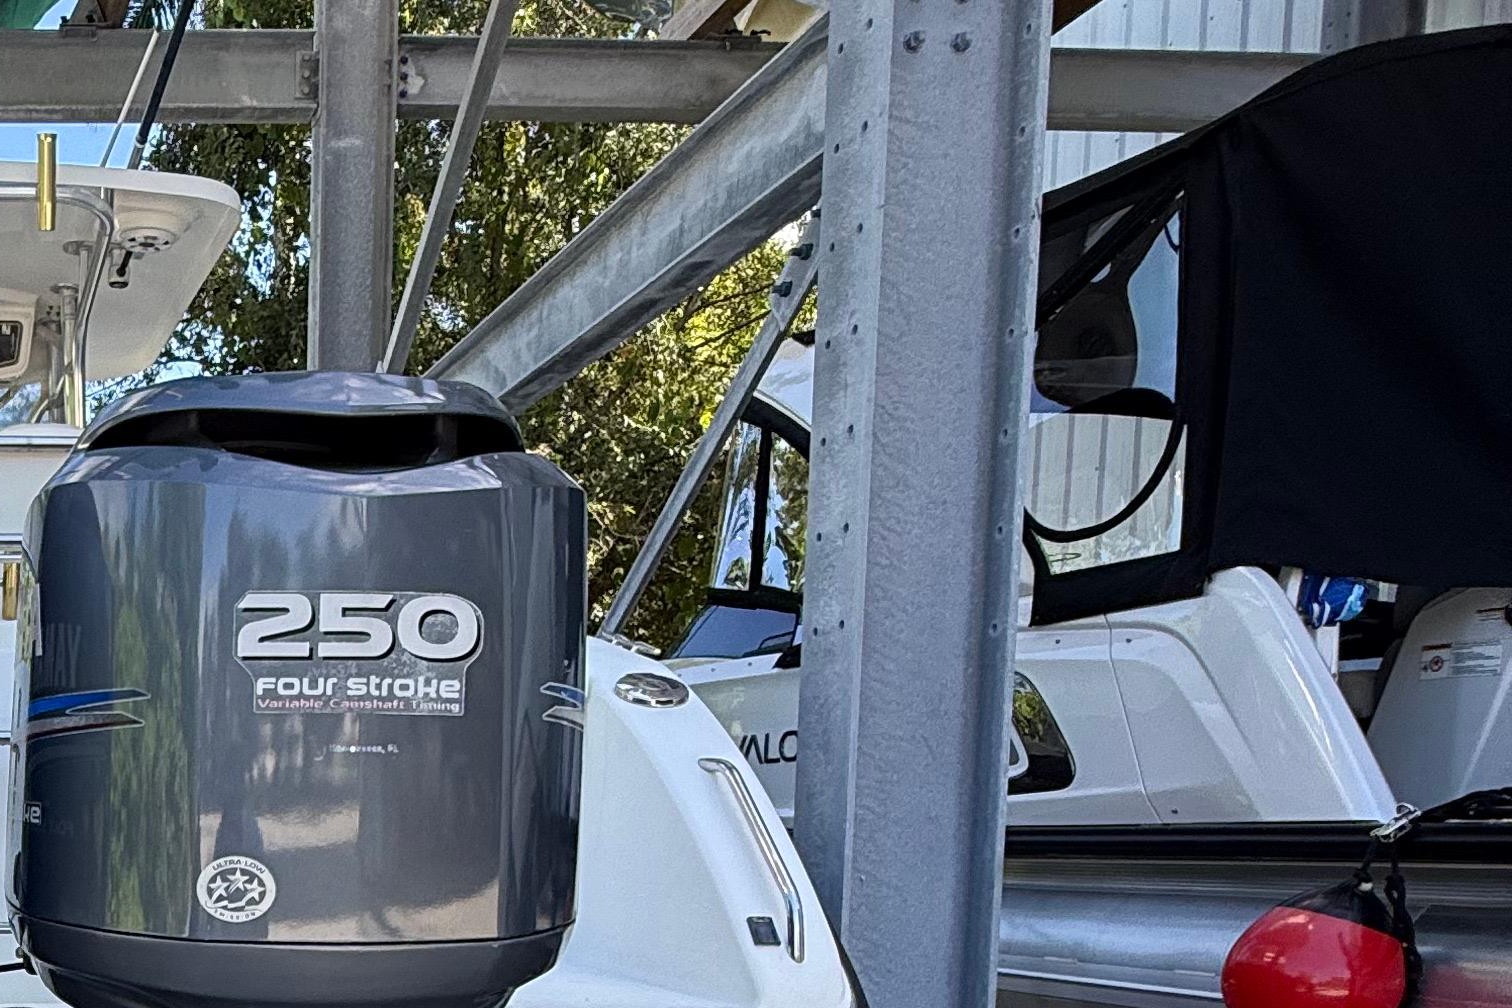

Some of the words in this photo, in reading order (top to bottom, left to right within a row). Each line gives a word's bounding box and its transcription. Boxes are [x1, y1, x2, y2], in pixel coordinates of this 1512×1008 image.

[237, 592, 482, 663] 250
[257, 698, 324, 710] Variable
[330, 698, 406, 710] Camshaft
[411, 699, 461, 714] Timing
